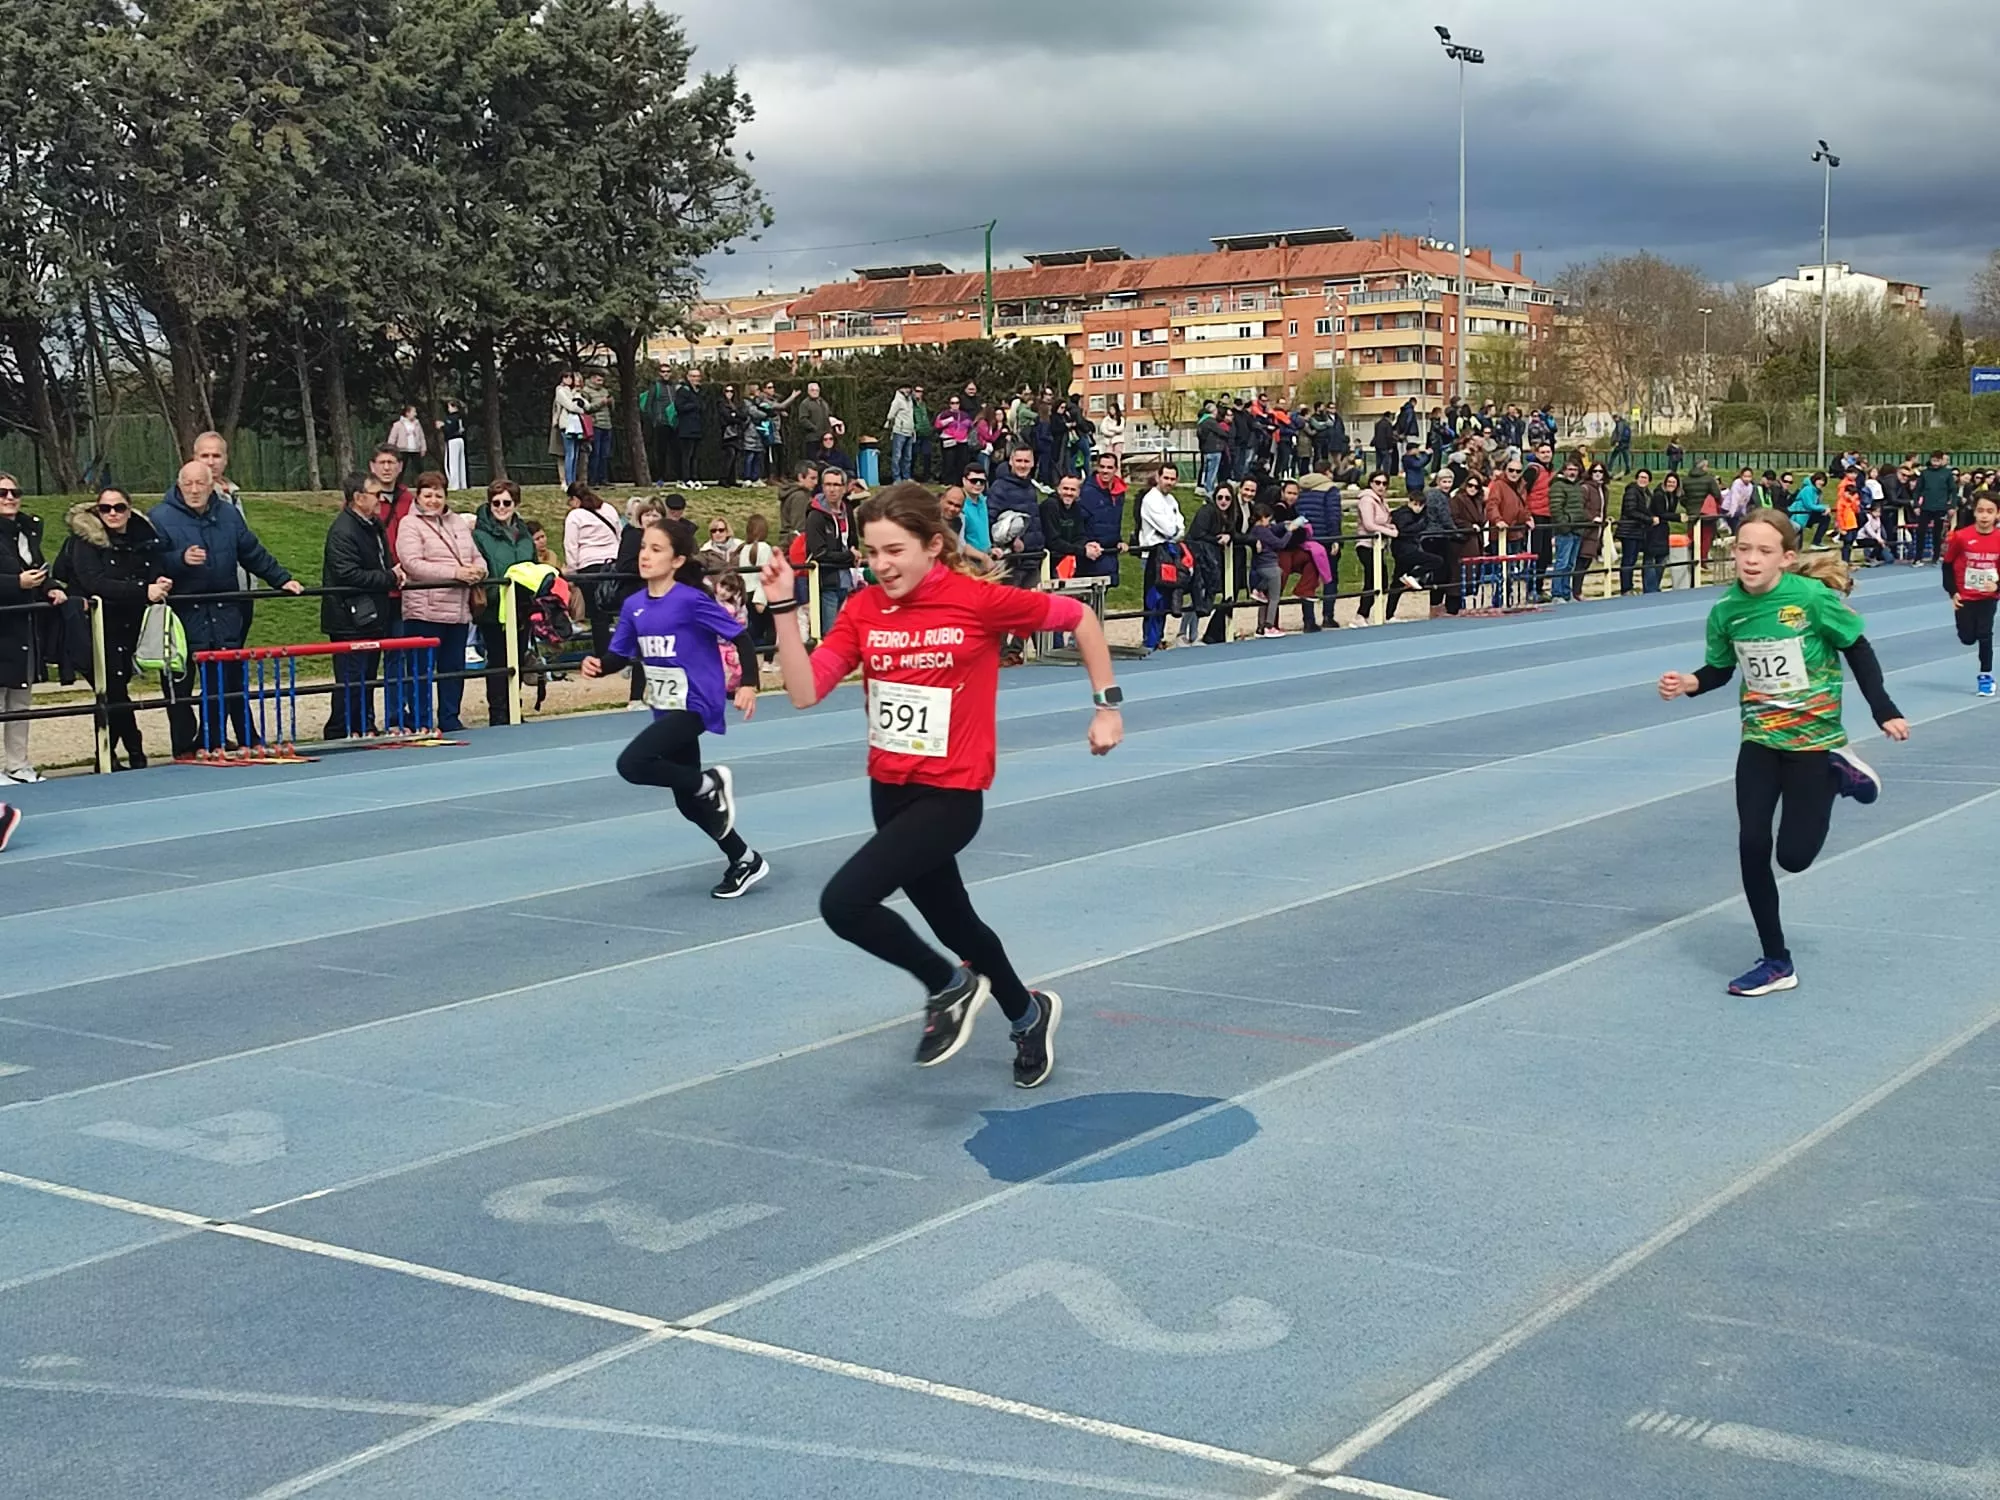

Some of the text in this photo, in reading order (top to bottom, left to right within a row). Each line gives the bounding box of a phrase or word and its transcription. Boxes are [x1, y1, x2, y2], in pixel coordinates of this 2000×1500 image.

[867, 627, 964, 648] PEDRO J. RUBIO
[870, 652, 954, 671] C.P. HUESCA
[1747, 655, 1789, 678] 512
[879, 701, 928, 733] 591
[482, 1175, 786, 1252] 3
[948, 1258, 1296, 1358] 2
